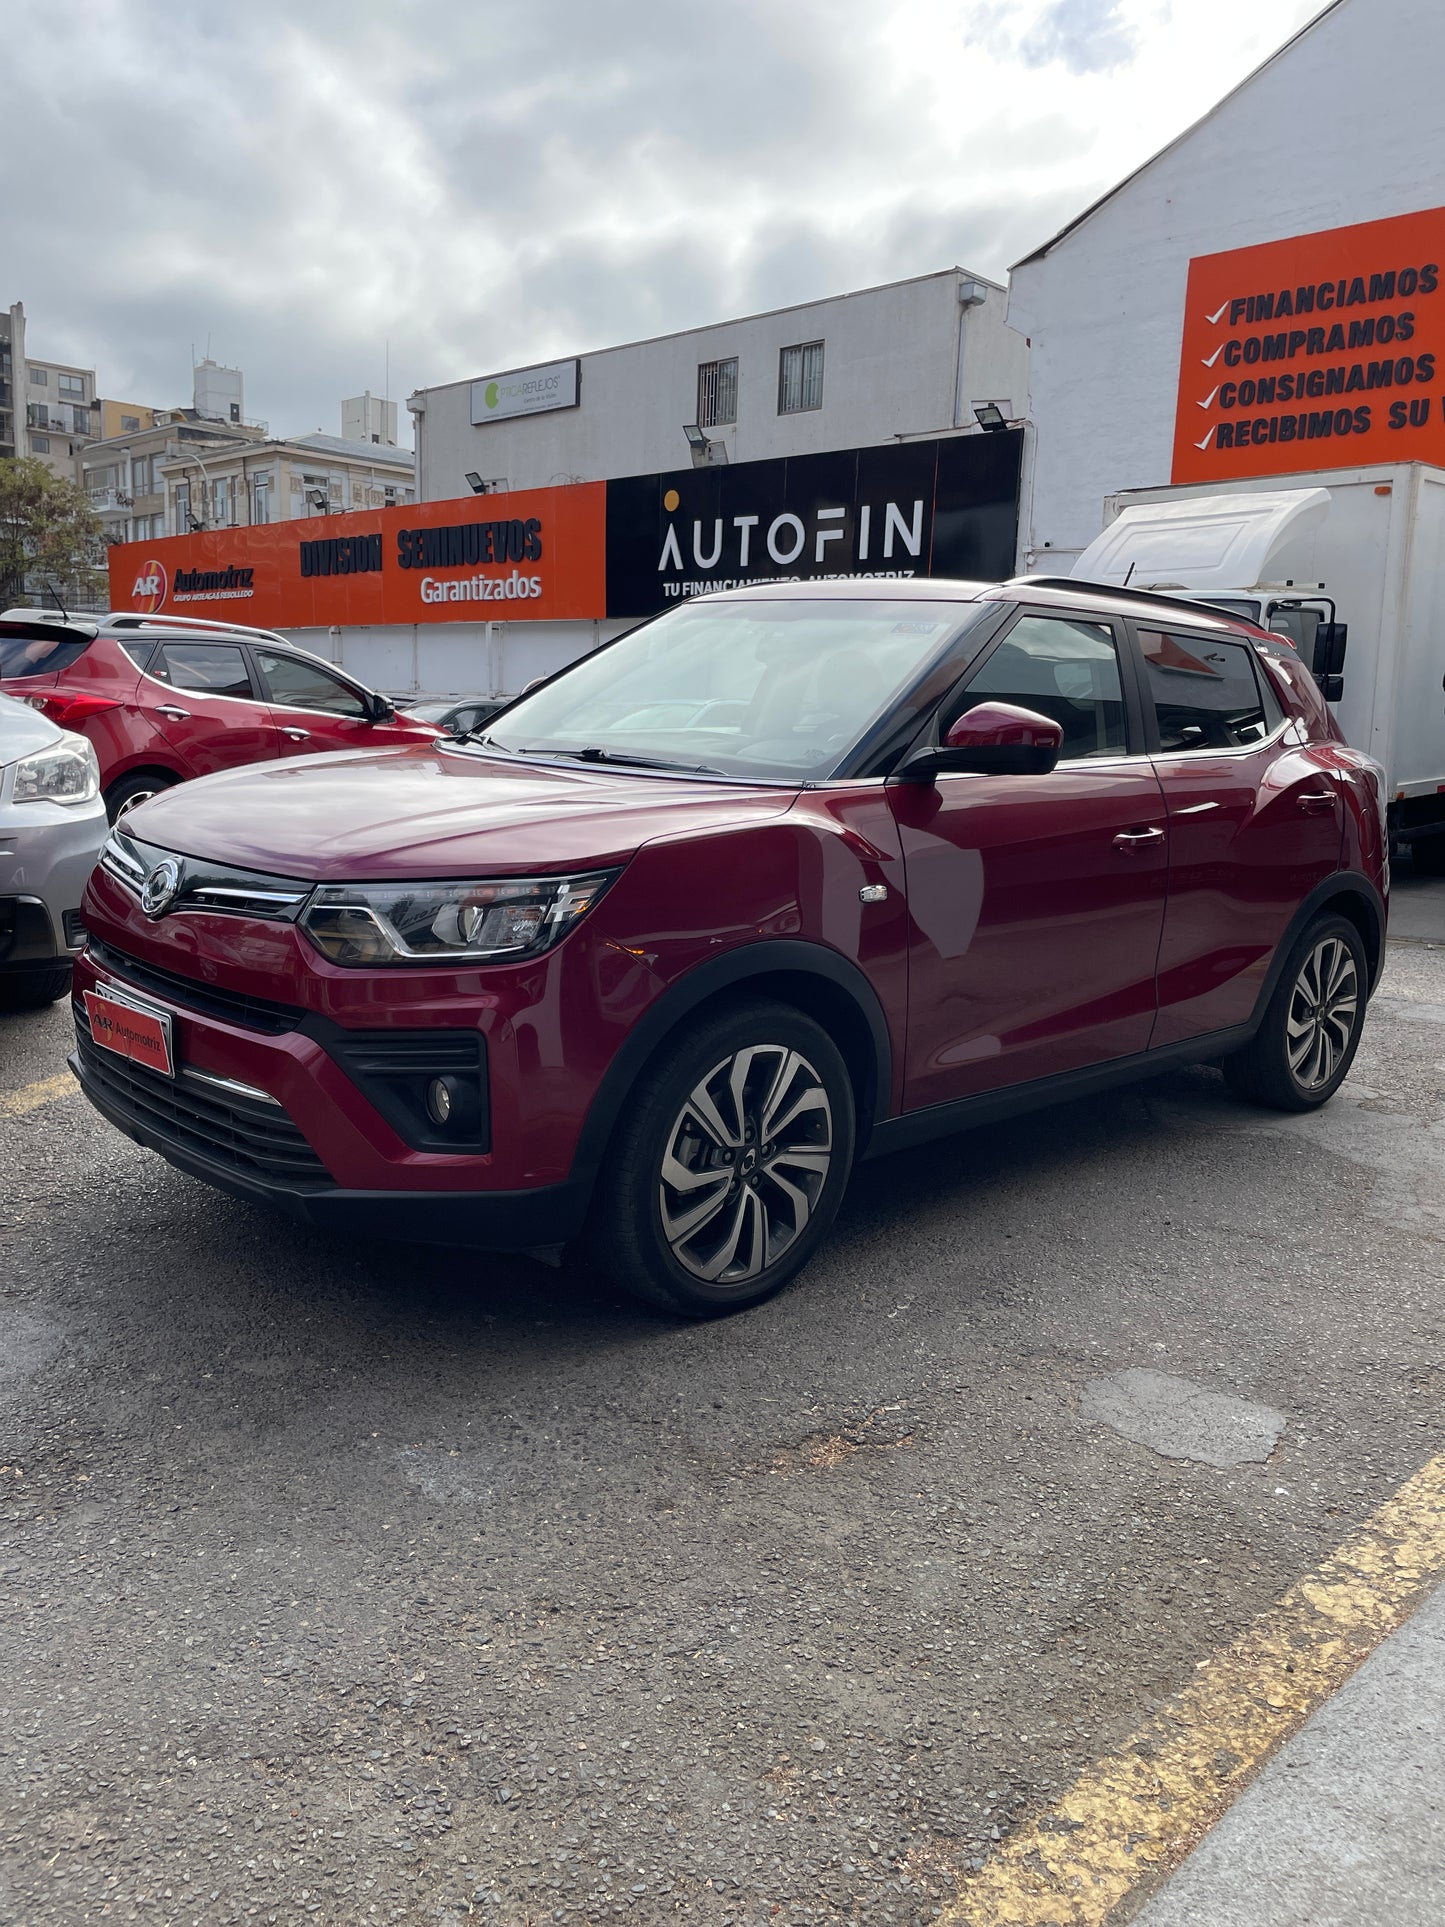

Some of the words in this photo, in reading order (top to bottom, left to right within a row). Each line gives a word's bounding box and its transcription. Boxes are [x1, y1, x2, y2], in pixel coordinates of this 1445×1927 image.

[1229, 263, 1439, 326] FINANCIAMOS
[1224, 311, 1415, 367] COMPRAMOS
[1219, 353, 1435, 409] CONSIGNAMOS
[1215, 405, 1372, 449] RECIBIMOS
[1388, 398, 1430, 429] SU
[300, 533, 383, 577] DIVISION
[397, 517, 542, 569] SEMINUEVOS
[658, 500, 924, 571] AUTOFIN
[173, 564, 254, 593] Automotriz
[420, 569, 542, 604] Garantizados
[663, 583, 681, 597] TU
[115, 1022, 161, 1052] Automotriz
